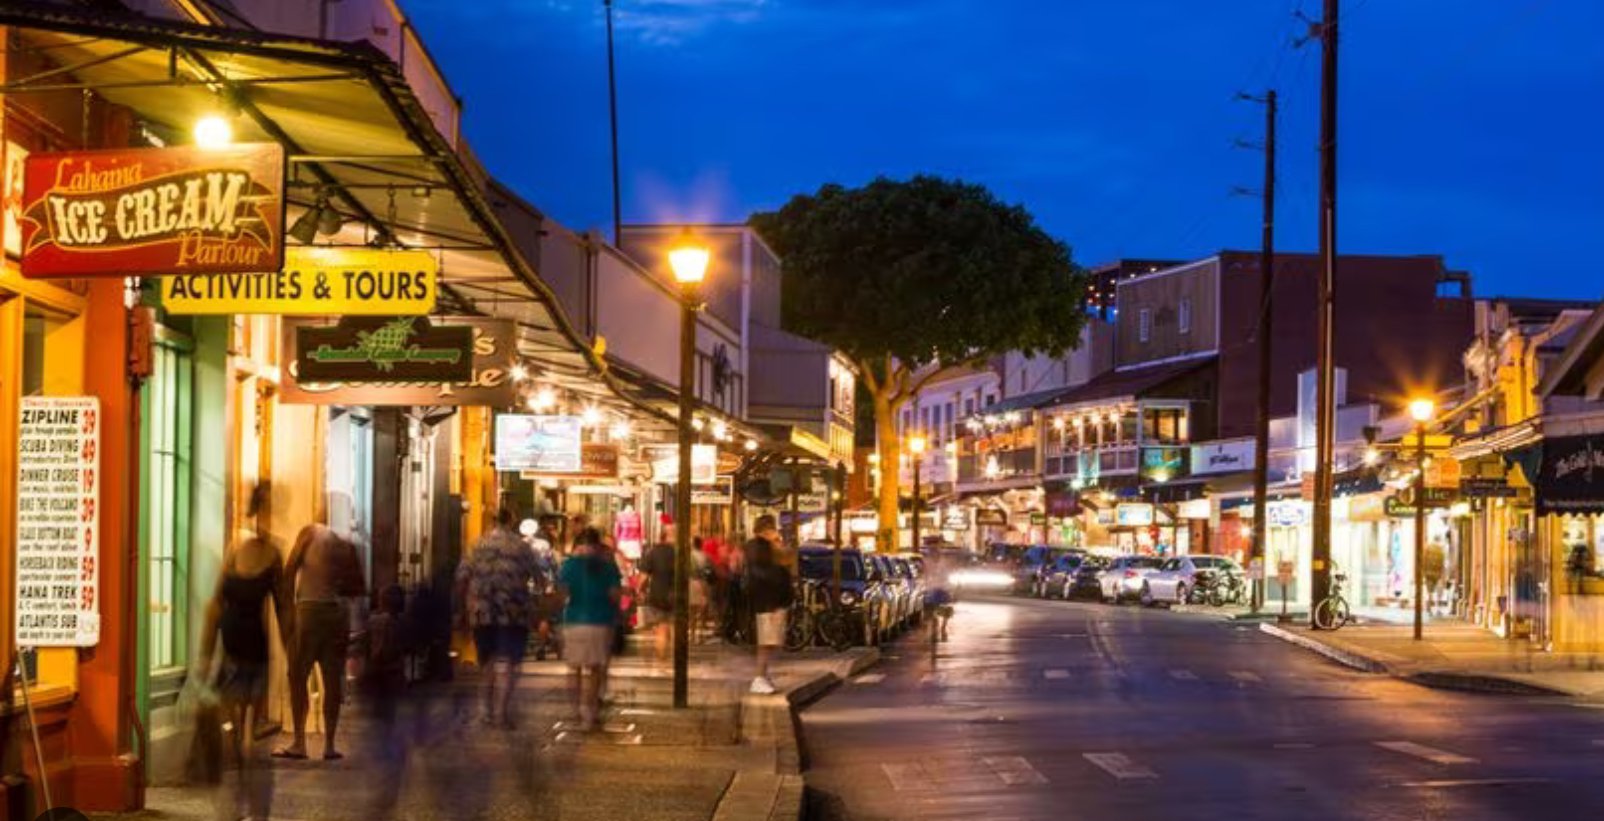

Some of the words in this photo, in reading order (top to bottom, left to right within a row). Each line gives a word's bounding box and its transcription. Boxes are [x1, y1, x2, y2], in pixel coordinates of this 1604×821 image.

[55, 158, 143, 192] Lahaina
[50, 196, 108, 244] ICE
[115, 172, 246, 242] CREAM
[176, 231, 263, 266] Parlour
[170, 272, 301, 299] ACTIVITIES
[313, 273, 331, 299] &
[344, 272, 427, 299] TOURS
[21, 410, 78, 424] ZIPLINE
[20, 439, 46, 452] SCUBA
[50, 439, 78, 452] DIVING
[20, 469, 48, 481] DINNER
[52, 469, 78, 481] CRUISE
[83, 469, 93, 493] 19
[37, 498, 48, 511] THE
[50, 498, 78, 511] VOLCANO
[37, 527, 60, 540] BOTTOM
[63, 527, 78, 540] BOAT
[85, 527, 92, 551] 9
[20, 557, 54, 569] HORSEBACK
[57, 557, 78, 569] RIDING
[20, 586, 47, 598] HANA
[52, 586, 77, 598] TREK
[19, 614, 58, 628] ATLANTIS
[61, 614, 77, 628] SUB
